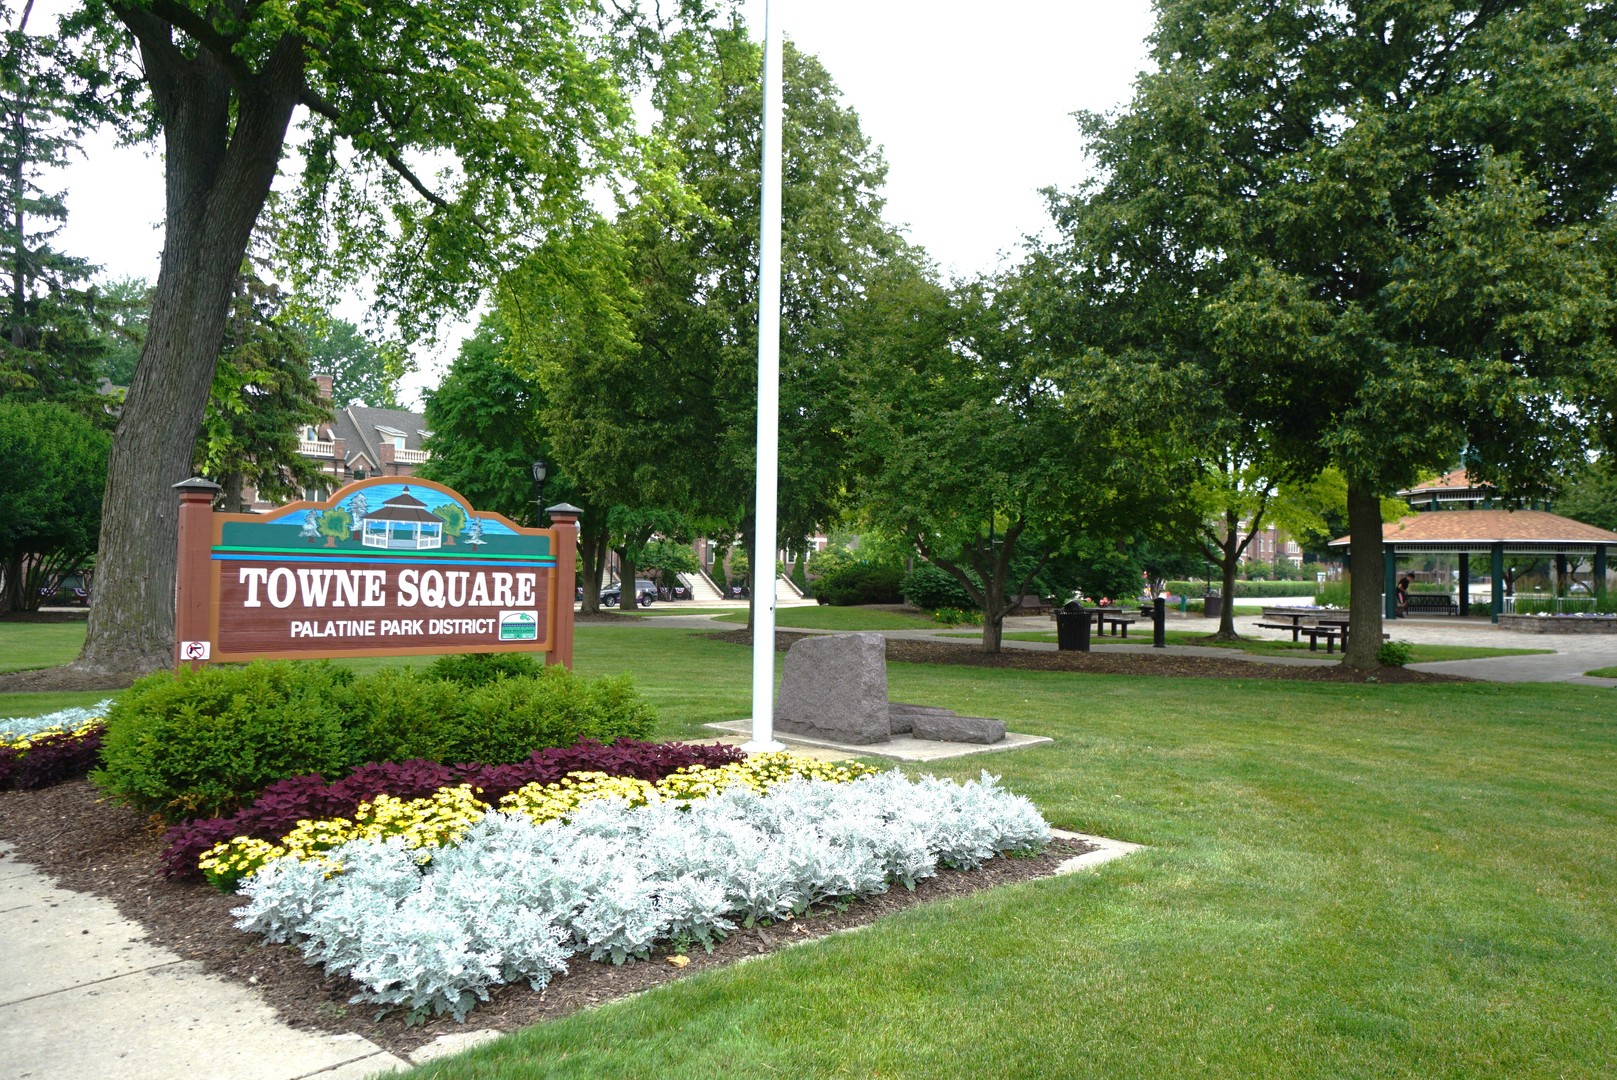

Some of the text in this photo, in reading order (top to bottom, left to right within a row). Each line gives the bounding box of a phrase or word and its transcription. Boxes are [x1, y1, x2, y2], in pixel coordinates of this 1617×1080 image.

[239, 567, 537, 609] TOWNE SQUARE
[290, 618, 496, 638] PALATINE PARK DISTRICT
